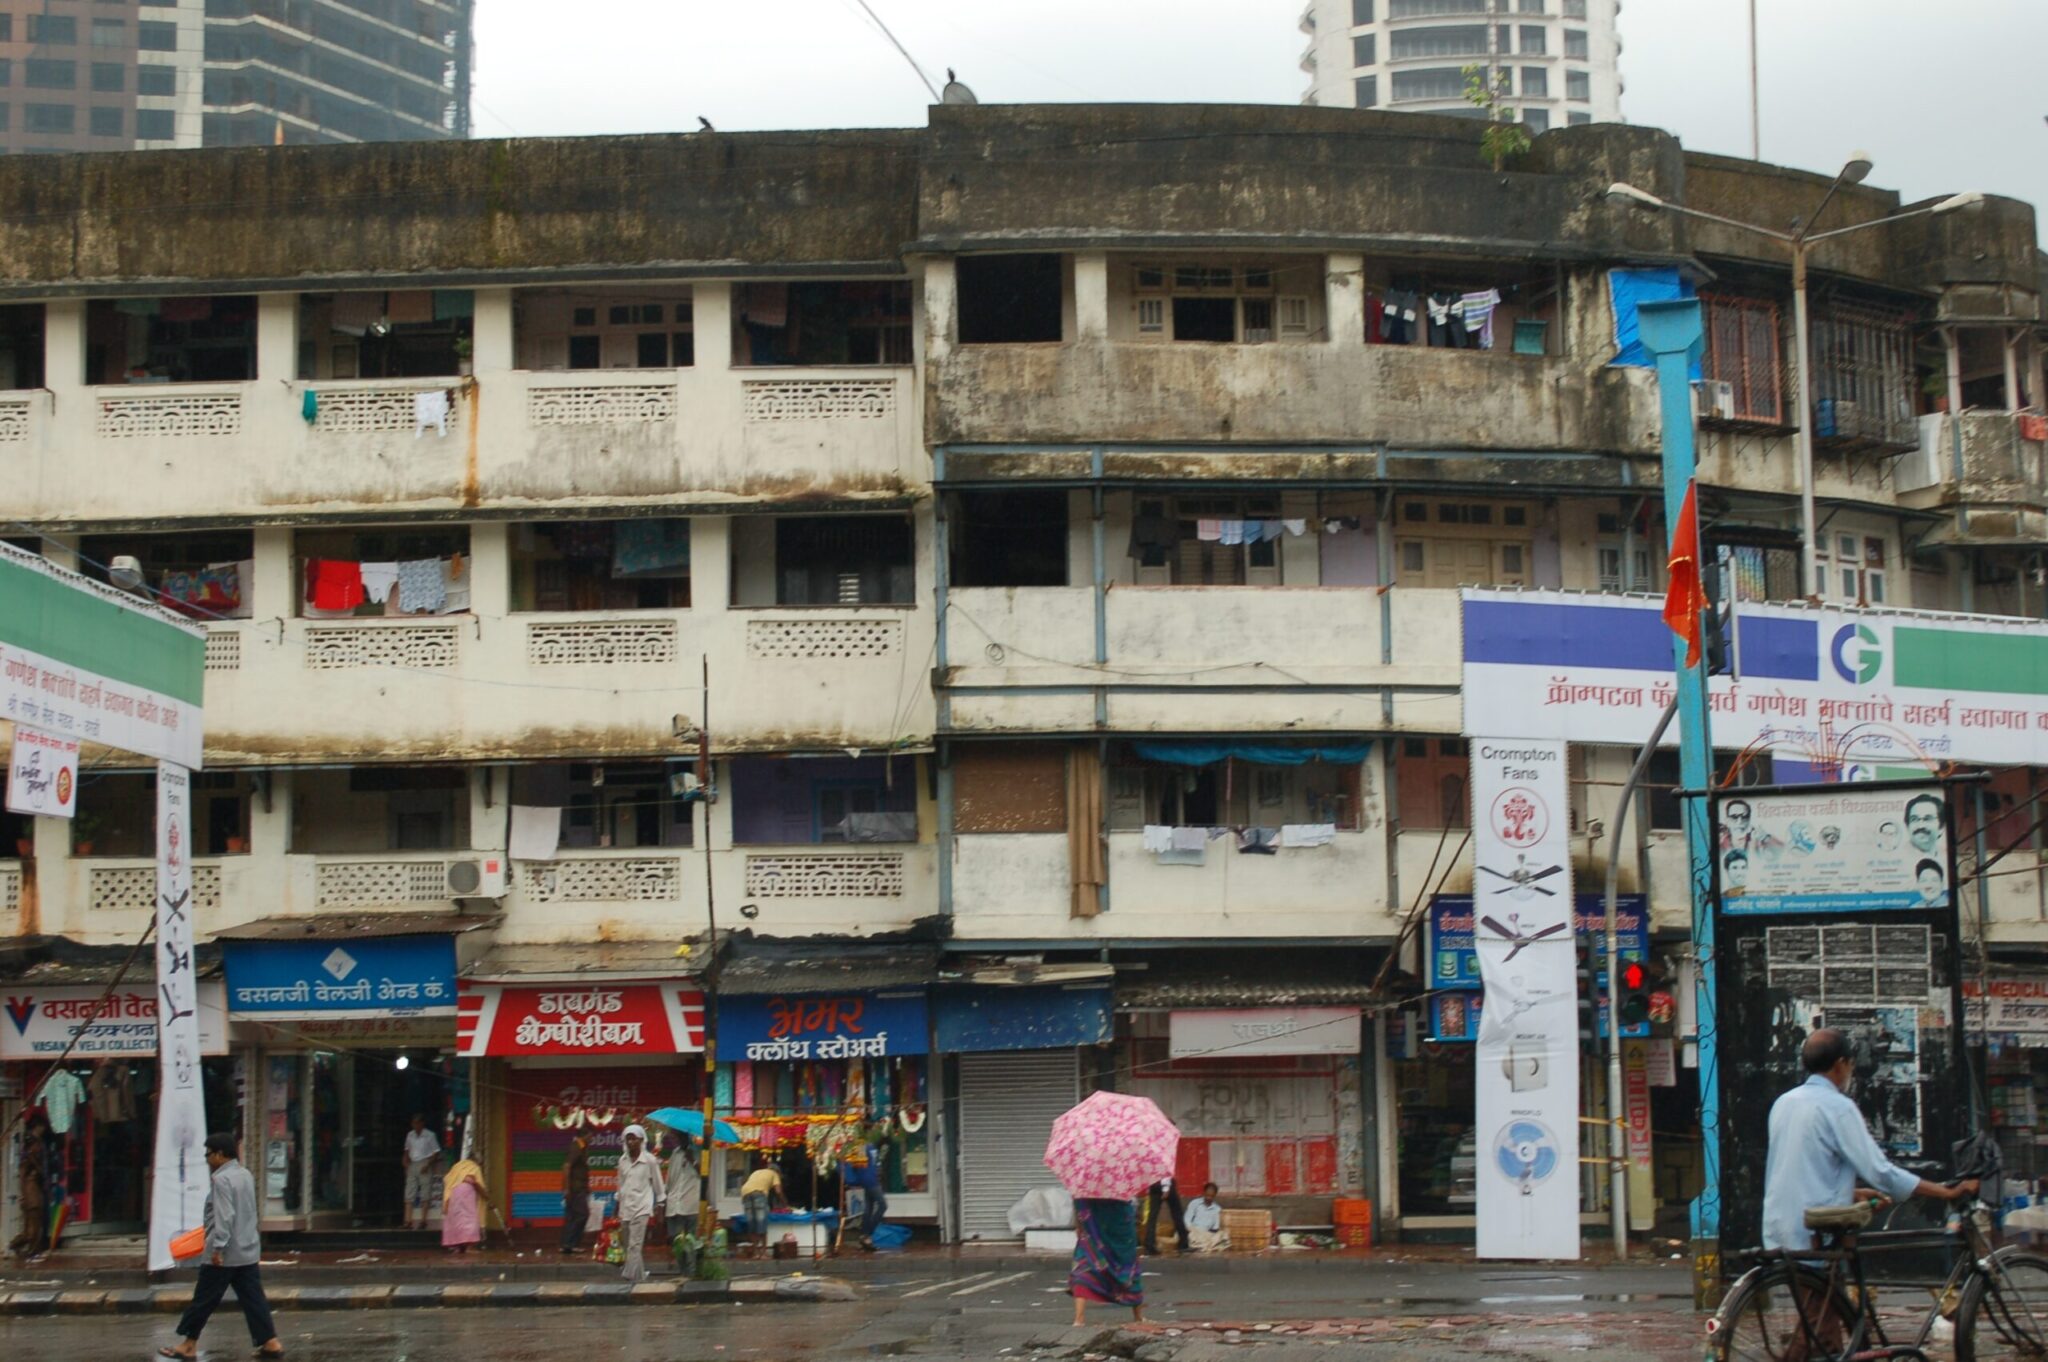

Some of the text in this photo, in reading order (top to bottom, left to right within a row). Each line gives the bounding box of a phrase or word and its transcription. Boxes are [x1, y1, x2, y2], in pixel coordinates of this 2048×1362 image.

[1747, 687, 1808, 718] गणेश
[1818, 694, 1894, 723] भक्तांचे
[1903, 698, 1955, 727] सहर्ष
[1960, 707, 2030, 731] स्वागत
[1481, 746, 1556, 763] Crompton
[1502, 766, 1539, 781] Fans
[236, 979, 311, 1003] वसनजी
[314, 978, 372, 1001] वेलजी
[537, 987, 624, 1015] डायमंड
[767, 995, 866, 1038] अमर
[747, 1031, 888, 1061] क्लॉथ स्टोअर्स
[582, 1085, 638, 1106] airtel
